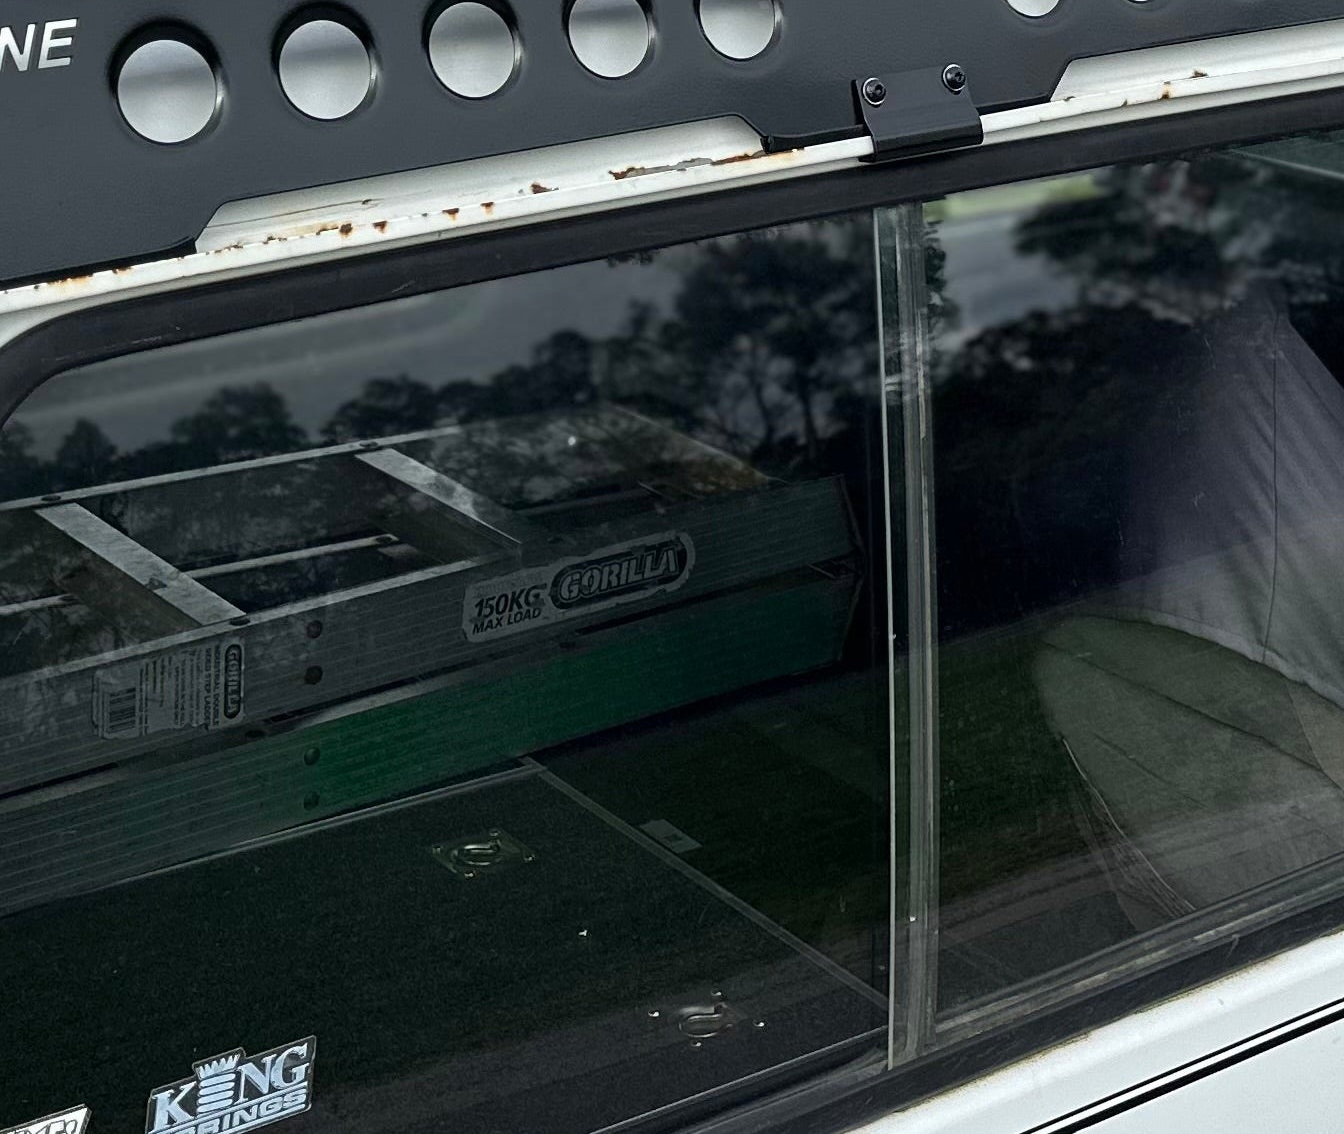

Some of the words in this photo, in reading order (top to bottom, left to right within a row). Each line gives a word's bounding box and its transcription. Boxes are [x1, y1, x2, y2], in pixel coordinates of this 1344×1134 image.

[559, 547, 680, 602] GORILLA
[472, 614, 504, 635] MAX
[506, 607, 542, 626] LOAD
[474, 583, 547, 619] 150KG
[151, 1042, 311, 1132] KING
[156, 1088, 308, 1134] RINGS
